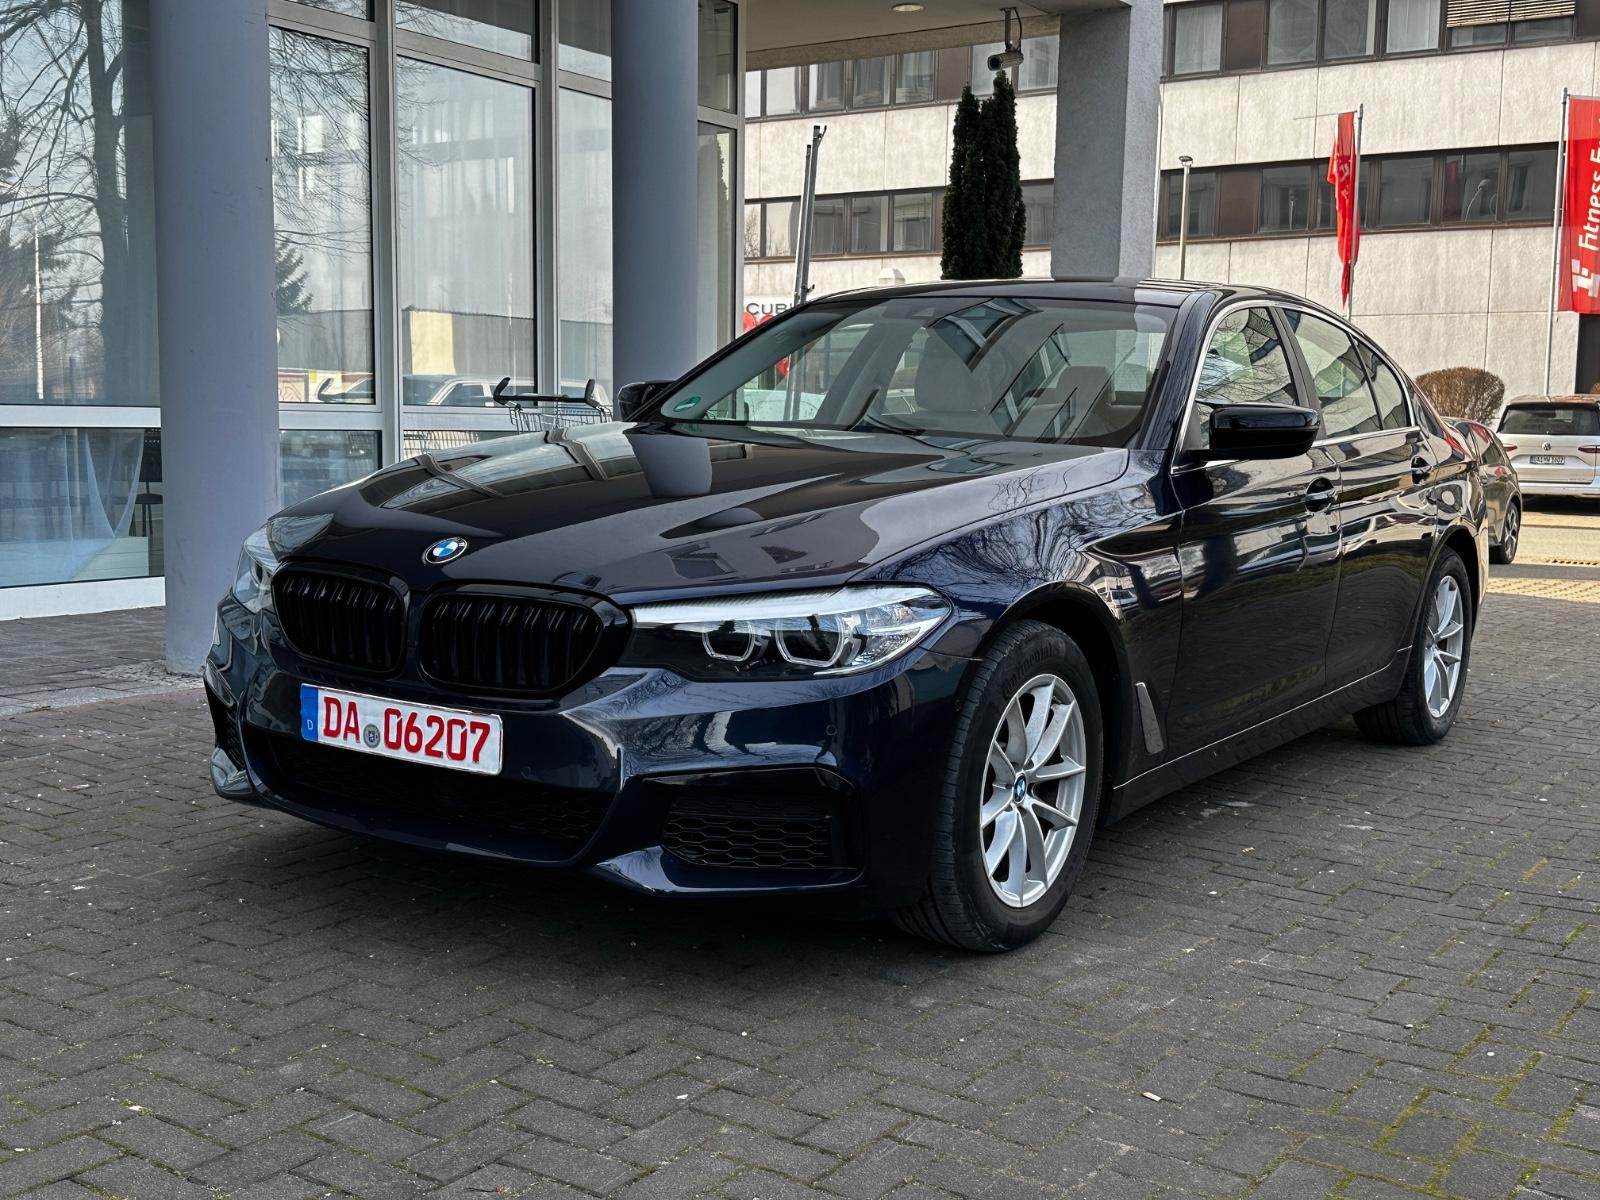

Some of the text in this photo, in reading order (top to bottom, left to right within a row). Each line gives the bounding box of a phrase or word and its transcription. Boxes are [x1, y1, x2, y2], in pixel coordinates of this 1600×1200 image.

[746, 302, 793, 316] CUB
[306, 719, 314, 731] D
[323, 696, 491, 764] DA 06207
